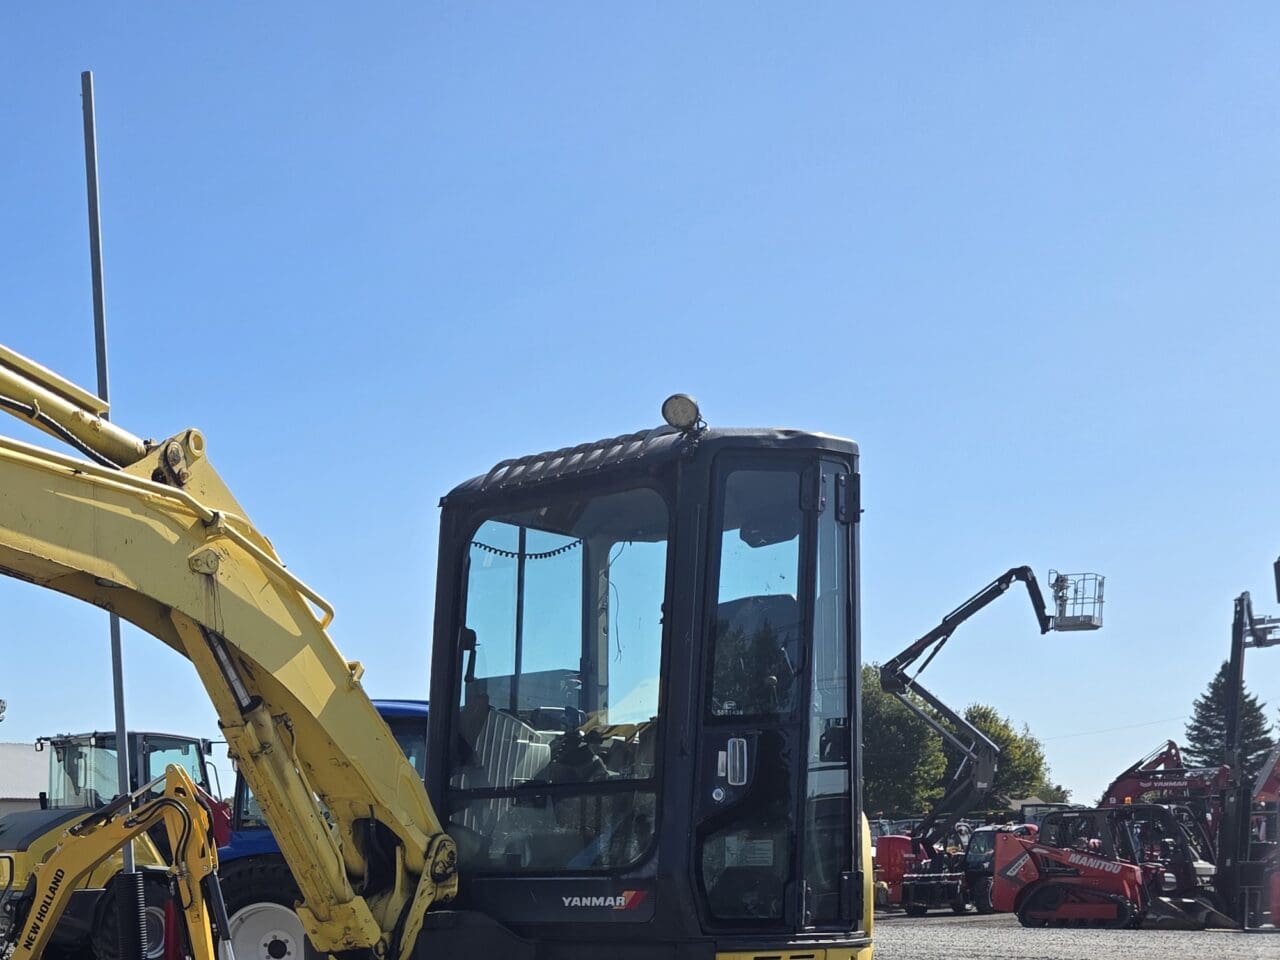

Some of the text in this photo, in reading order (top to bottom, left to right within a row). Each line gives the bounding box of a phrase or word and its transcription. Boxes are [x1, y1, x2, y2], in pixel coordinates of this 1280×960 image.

[1068, 853, 1121, 874] MANITOU
[23, 868, 65, 951] NEW HOLLAND
[562, 896, 626, 907] YANMAR
